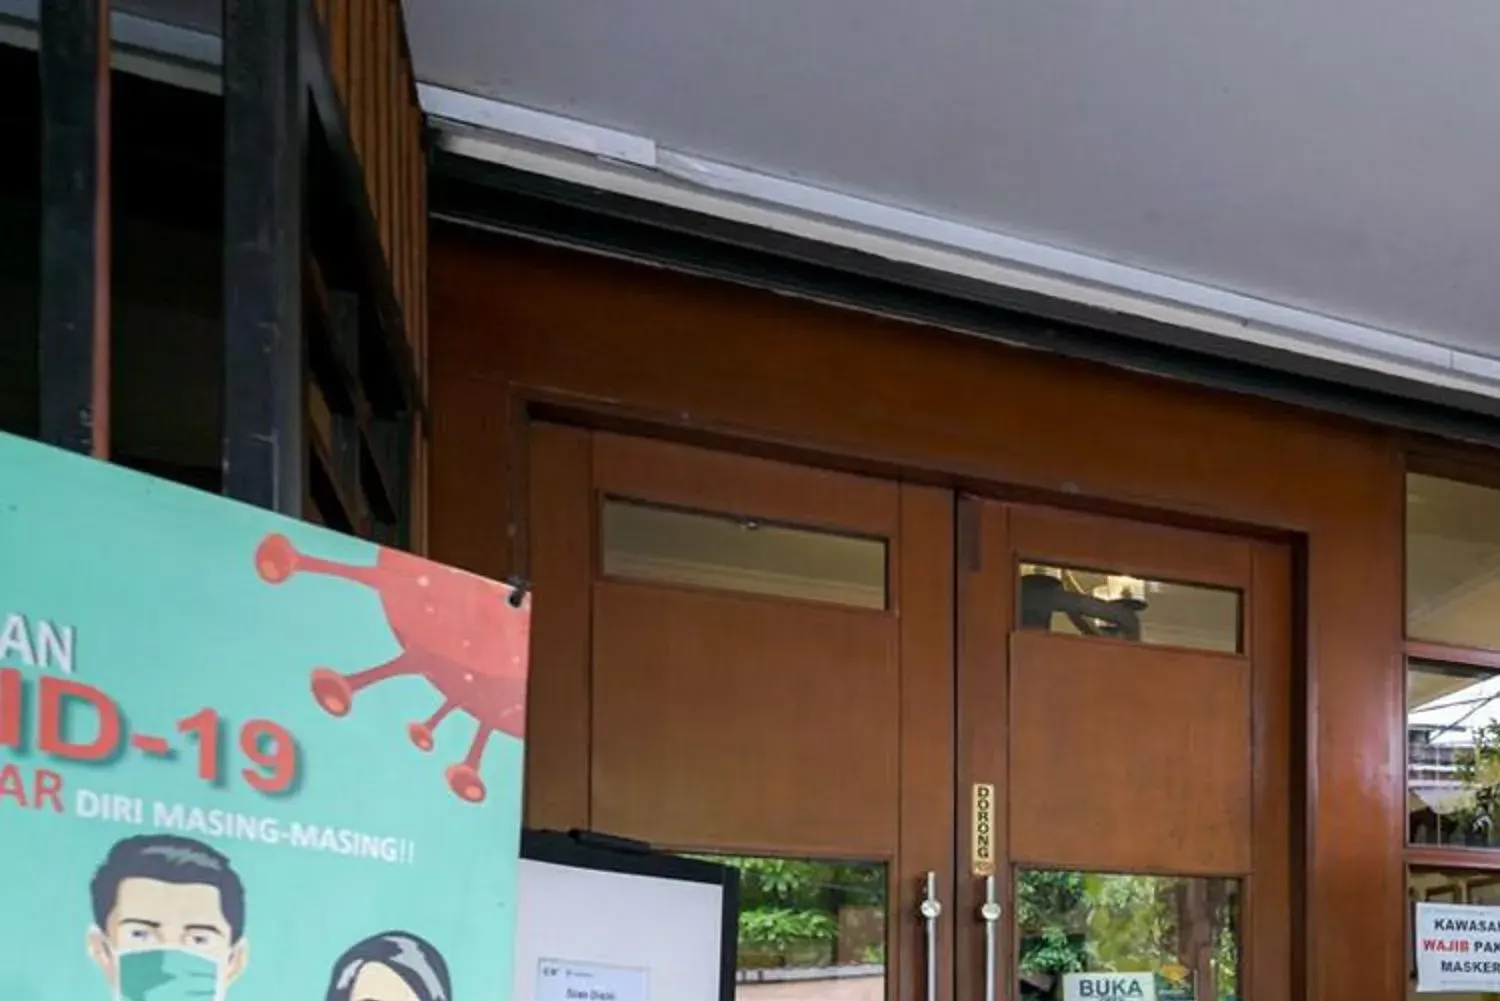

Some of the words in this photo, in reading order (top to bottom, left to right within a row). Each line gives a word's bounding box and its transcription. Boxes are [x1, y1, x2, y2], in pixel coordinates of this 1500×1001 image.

[76, 788, 142, 824] DIRI
[153, 801, 415, 863] MASING-MASING!!
[976, 787, 990, 858] DORONG
[1422, 939, 1470, 953] WAJIB
[1079, 979, 1144, 997] BUKA
